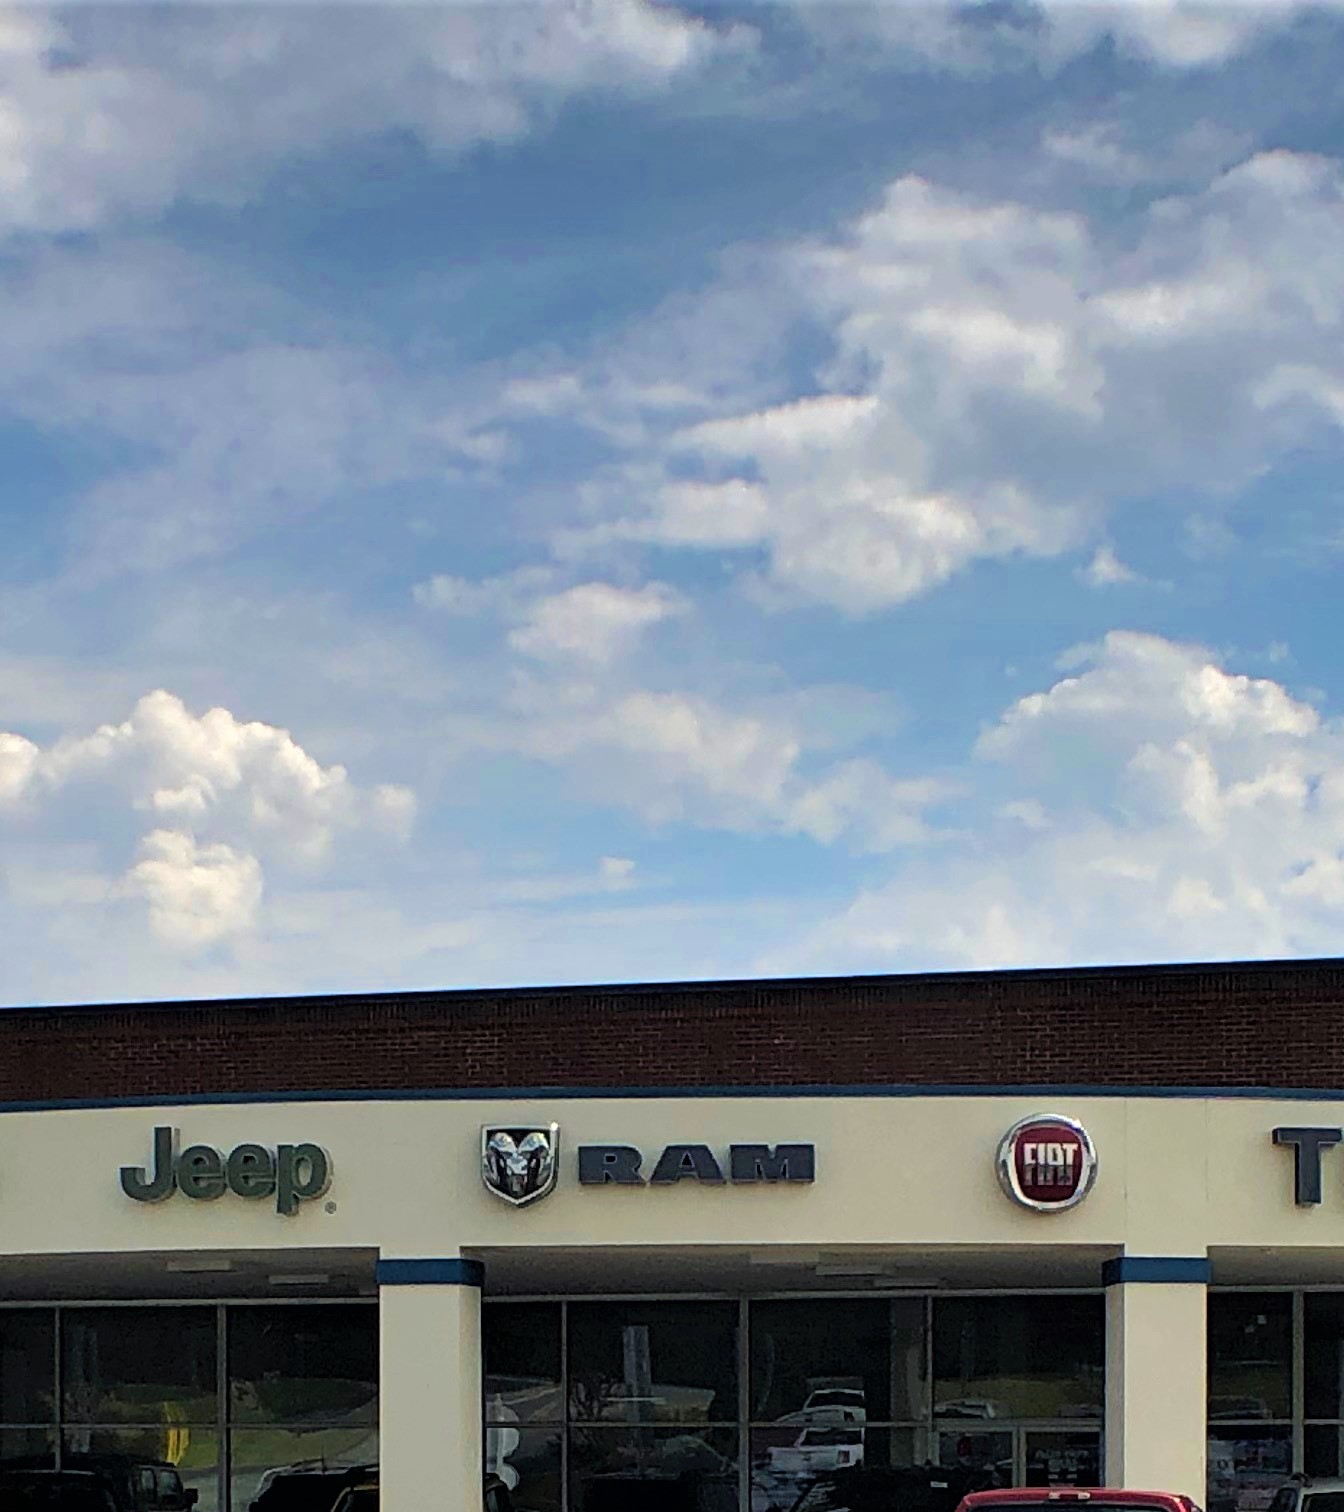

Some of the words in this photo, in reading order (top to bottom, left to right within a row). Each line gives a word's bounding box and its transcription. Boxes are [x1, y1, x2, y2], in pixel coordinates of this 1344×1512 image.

[120, 1126, 334, 1216] Jeep
[578, 1144, 815, 1185] RAM
[1023, 1142, 1079, 1166] FIAT
